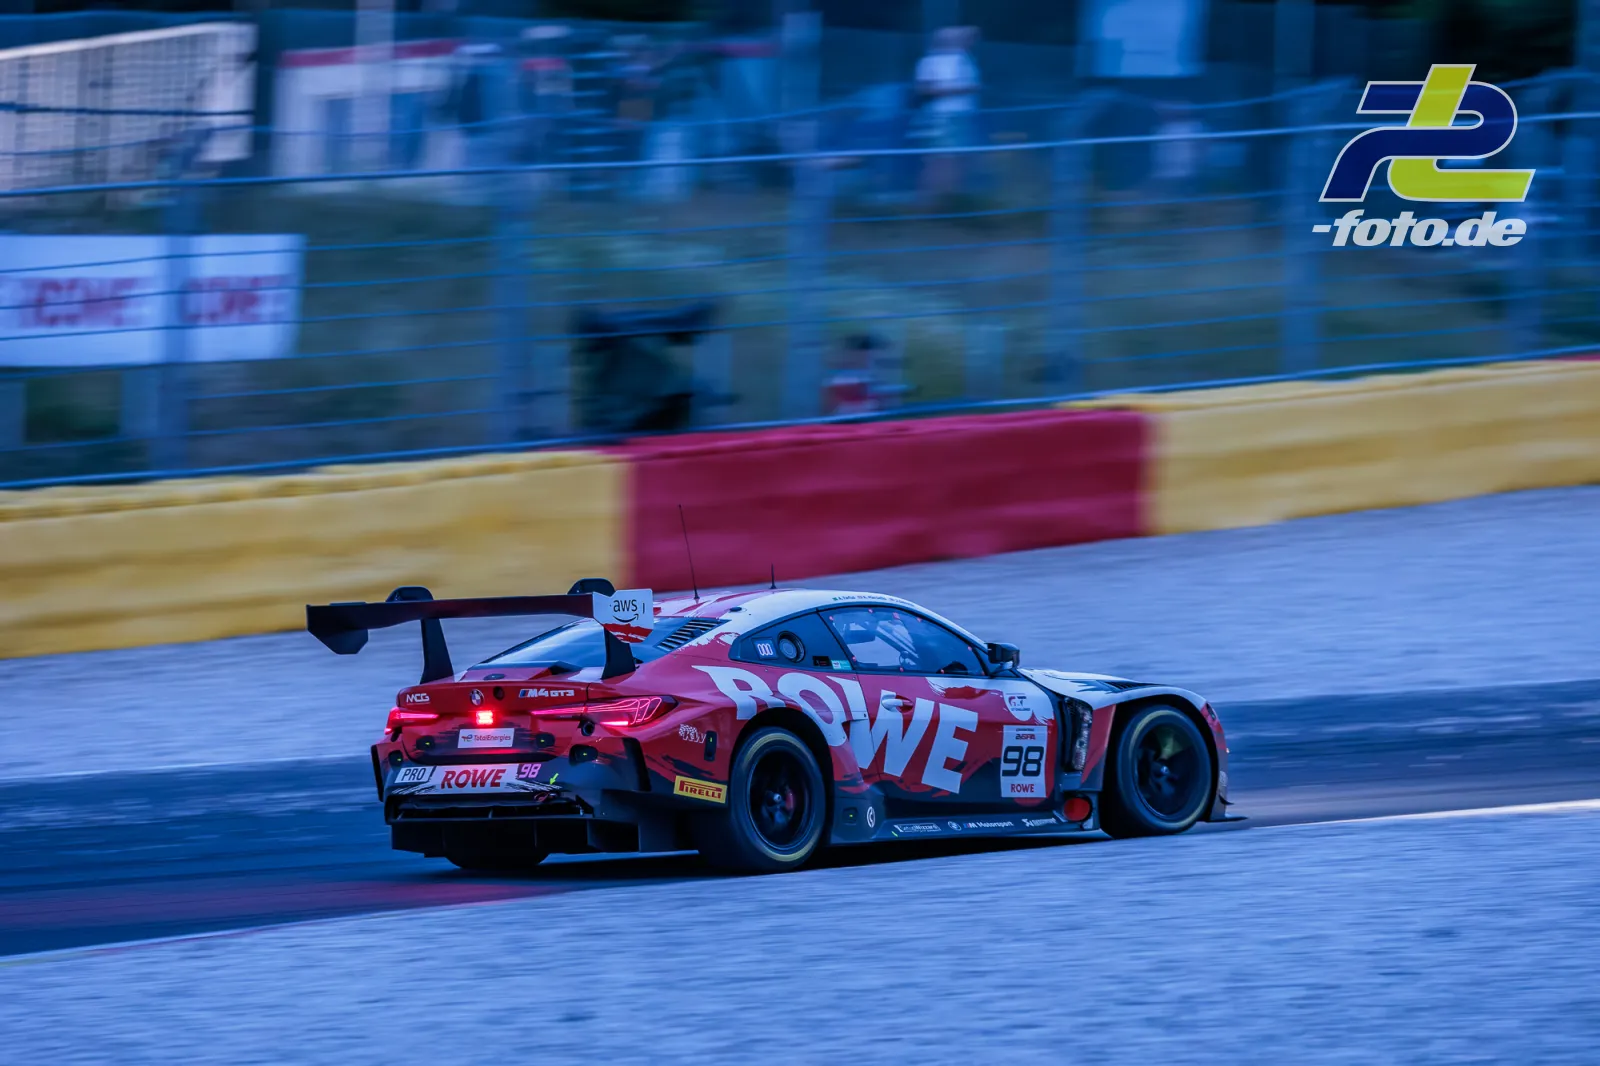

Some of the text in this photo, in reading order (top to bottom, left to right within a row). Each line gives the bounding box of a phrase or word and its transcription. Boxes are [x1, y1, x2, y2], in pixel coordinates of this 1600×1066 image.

[613, 599, 638, 613] aws
[406, 692, 430, 703] MCG
[525, 688, 575, 697] M4 GT3
[692, 665, 979, 794] ROWE
[473, 733, 512, 743] TotalEnergies
[1002, 745, 1045, 777] 98
[401, 767, 427, 781] PRO
[518, 763, 542, 779] 98
[440, 768, 507, 790] ROWE
[678, 779, 723, 799] PIRELLI
[1010, 783, 1035, 793] ROWE
